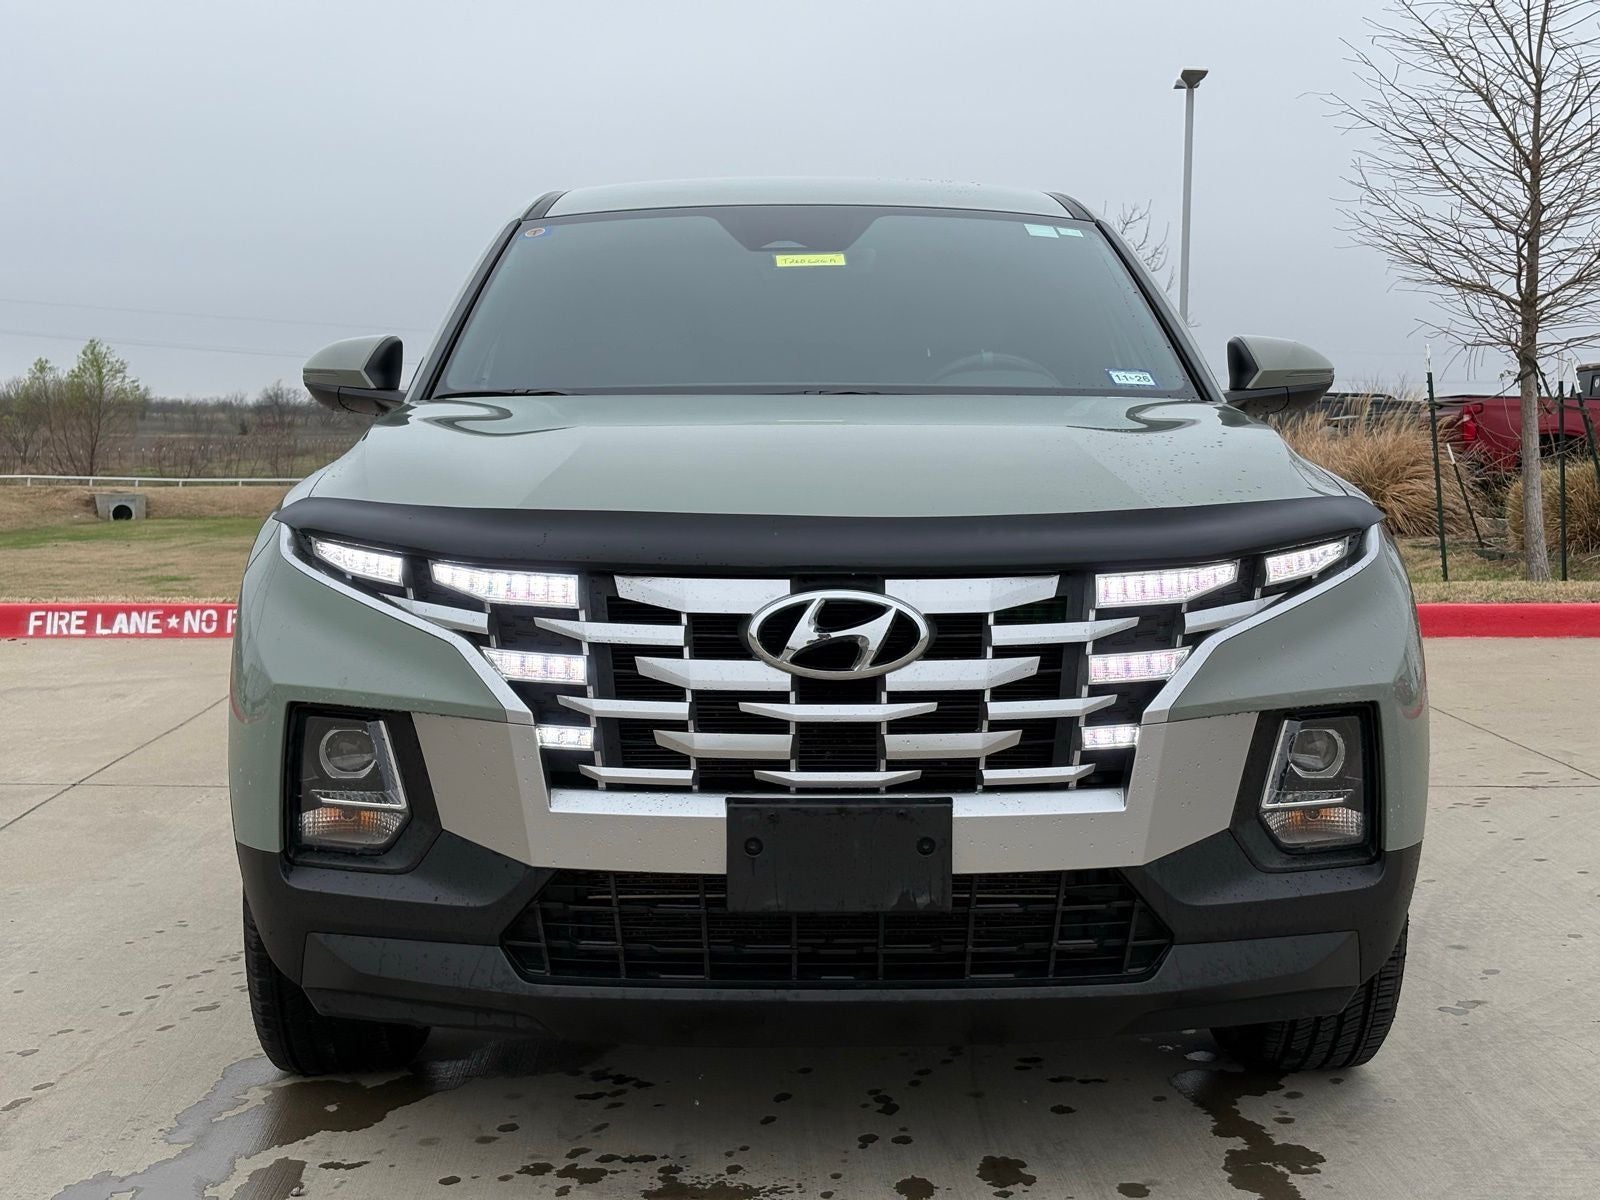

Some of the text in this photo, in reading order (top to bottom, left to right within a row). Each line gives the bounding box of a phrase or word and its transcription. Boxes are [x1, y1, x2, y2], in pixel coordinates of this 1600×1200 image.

[27, 611, 88, 635] FIRE
[95, 610, 164, 635] LANE
[183, 609, 218, 634] NO
